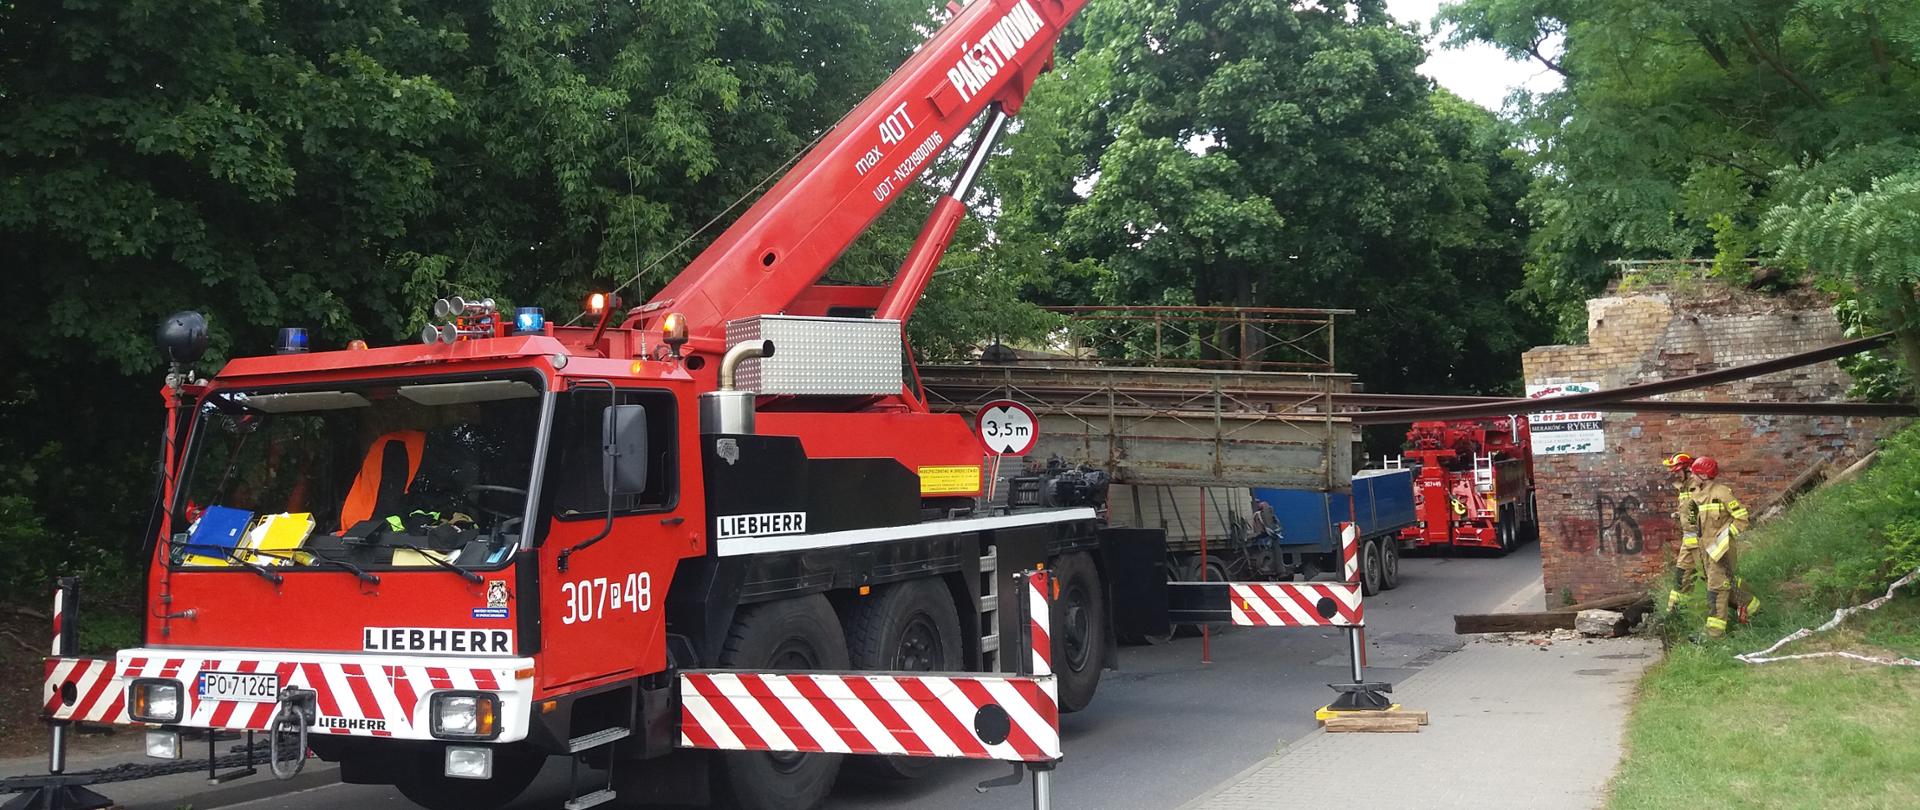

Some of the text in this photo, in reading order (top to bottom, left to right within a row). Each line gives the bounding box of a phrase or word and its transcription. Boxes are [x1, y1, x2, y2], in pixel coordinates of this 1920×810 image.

[855, 101, 915, 176] max 40T
[1567, 422, 1599, 431] RYNEK
[720, 514, 803, 536] LIEBHERR
[364, 629, 509, 652] LIEBHERR
[318, 717, 386, 731] LIEBHERR
